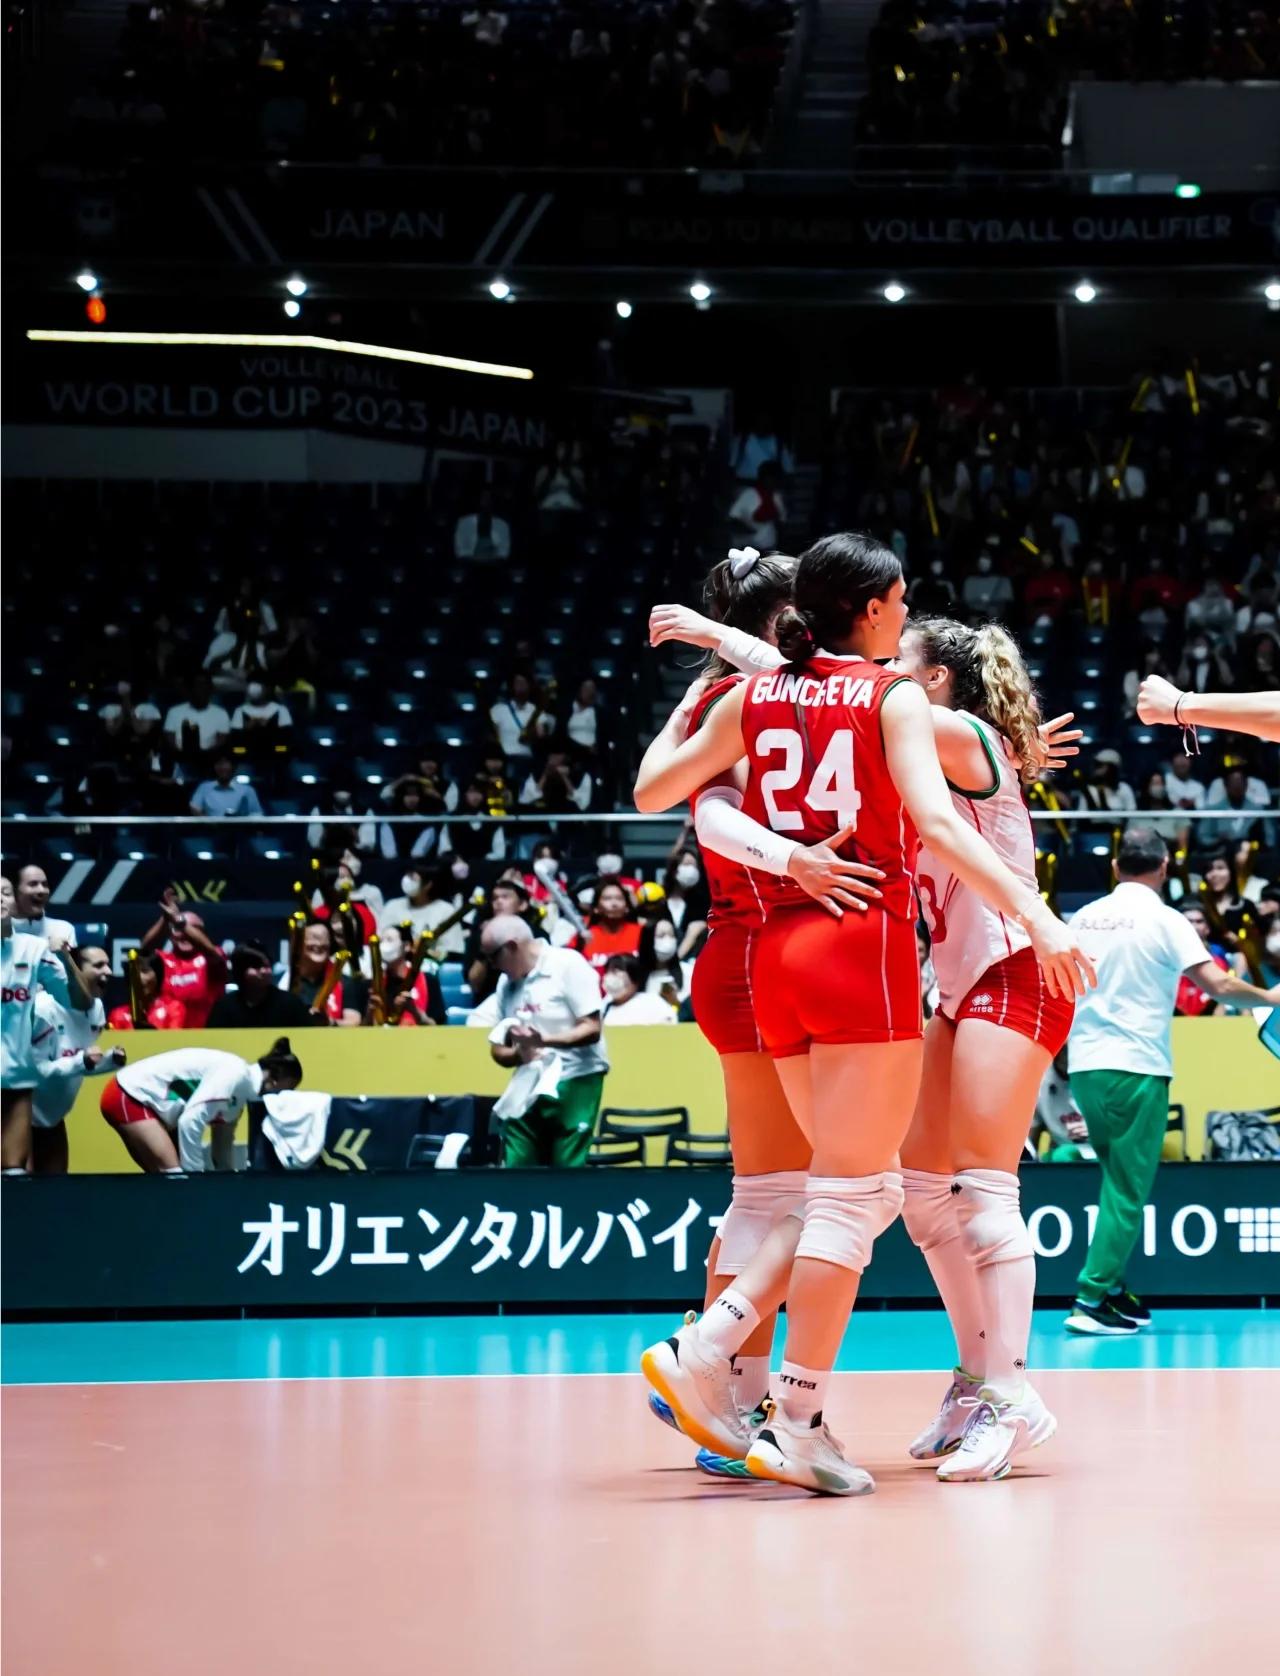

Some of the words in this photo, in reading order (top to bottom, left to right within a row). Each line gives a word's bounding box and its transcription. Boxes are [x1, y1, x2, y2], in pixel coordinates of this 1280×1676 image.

[311, 209, 445, 240] JAPAN
[863, 217, 1062, 243] VOLLEYBALL
[1073, 214, 1232, 243] QUALIFIER
[240, 356, 401, 390] VOLLEYBALL
[45, 382, 220, 417] WORLD
[232, 385, 322, 418] CUP
[333, 390, 429, 432] 2023
[438, 408, 546, 448] JAPAN
[755, 728, 862, 833] 24
